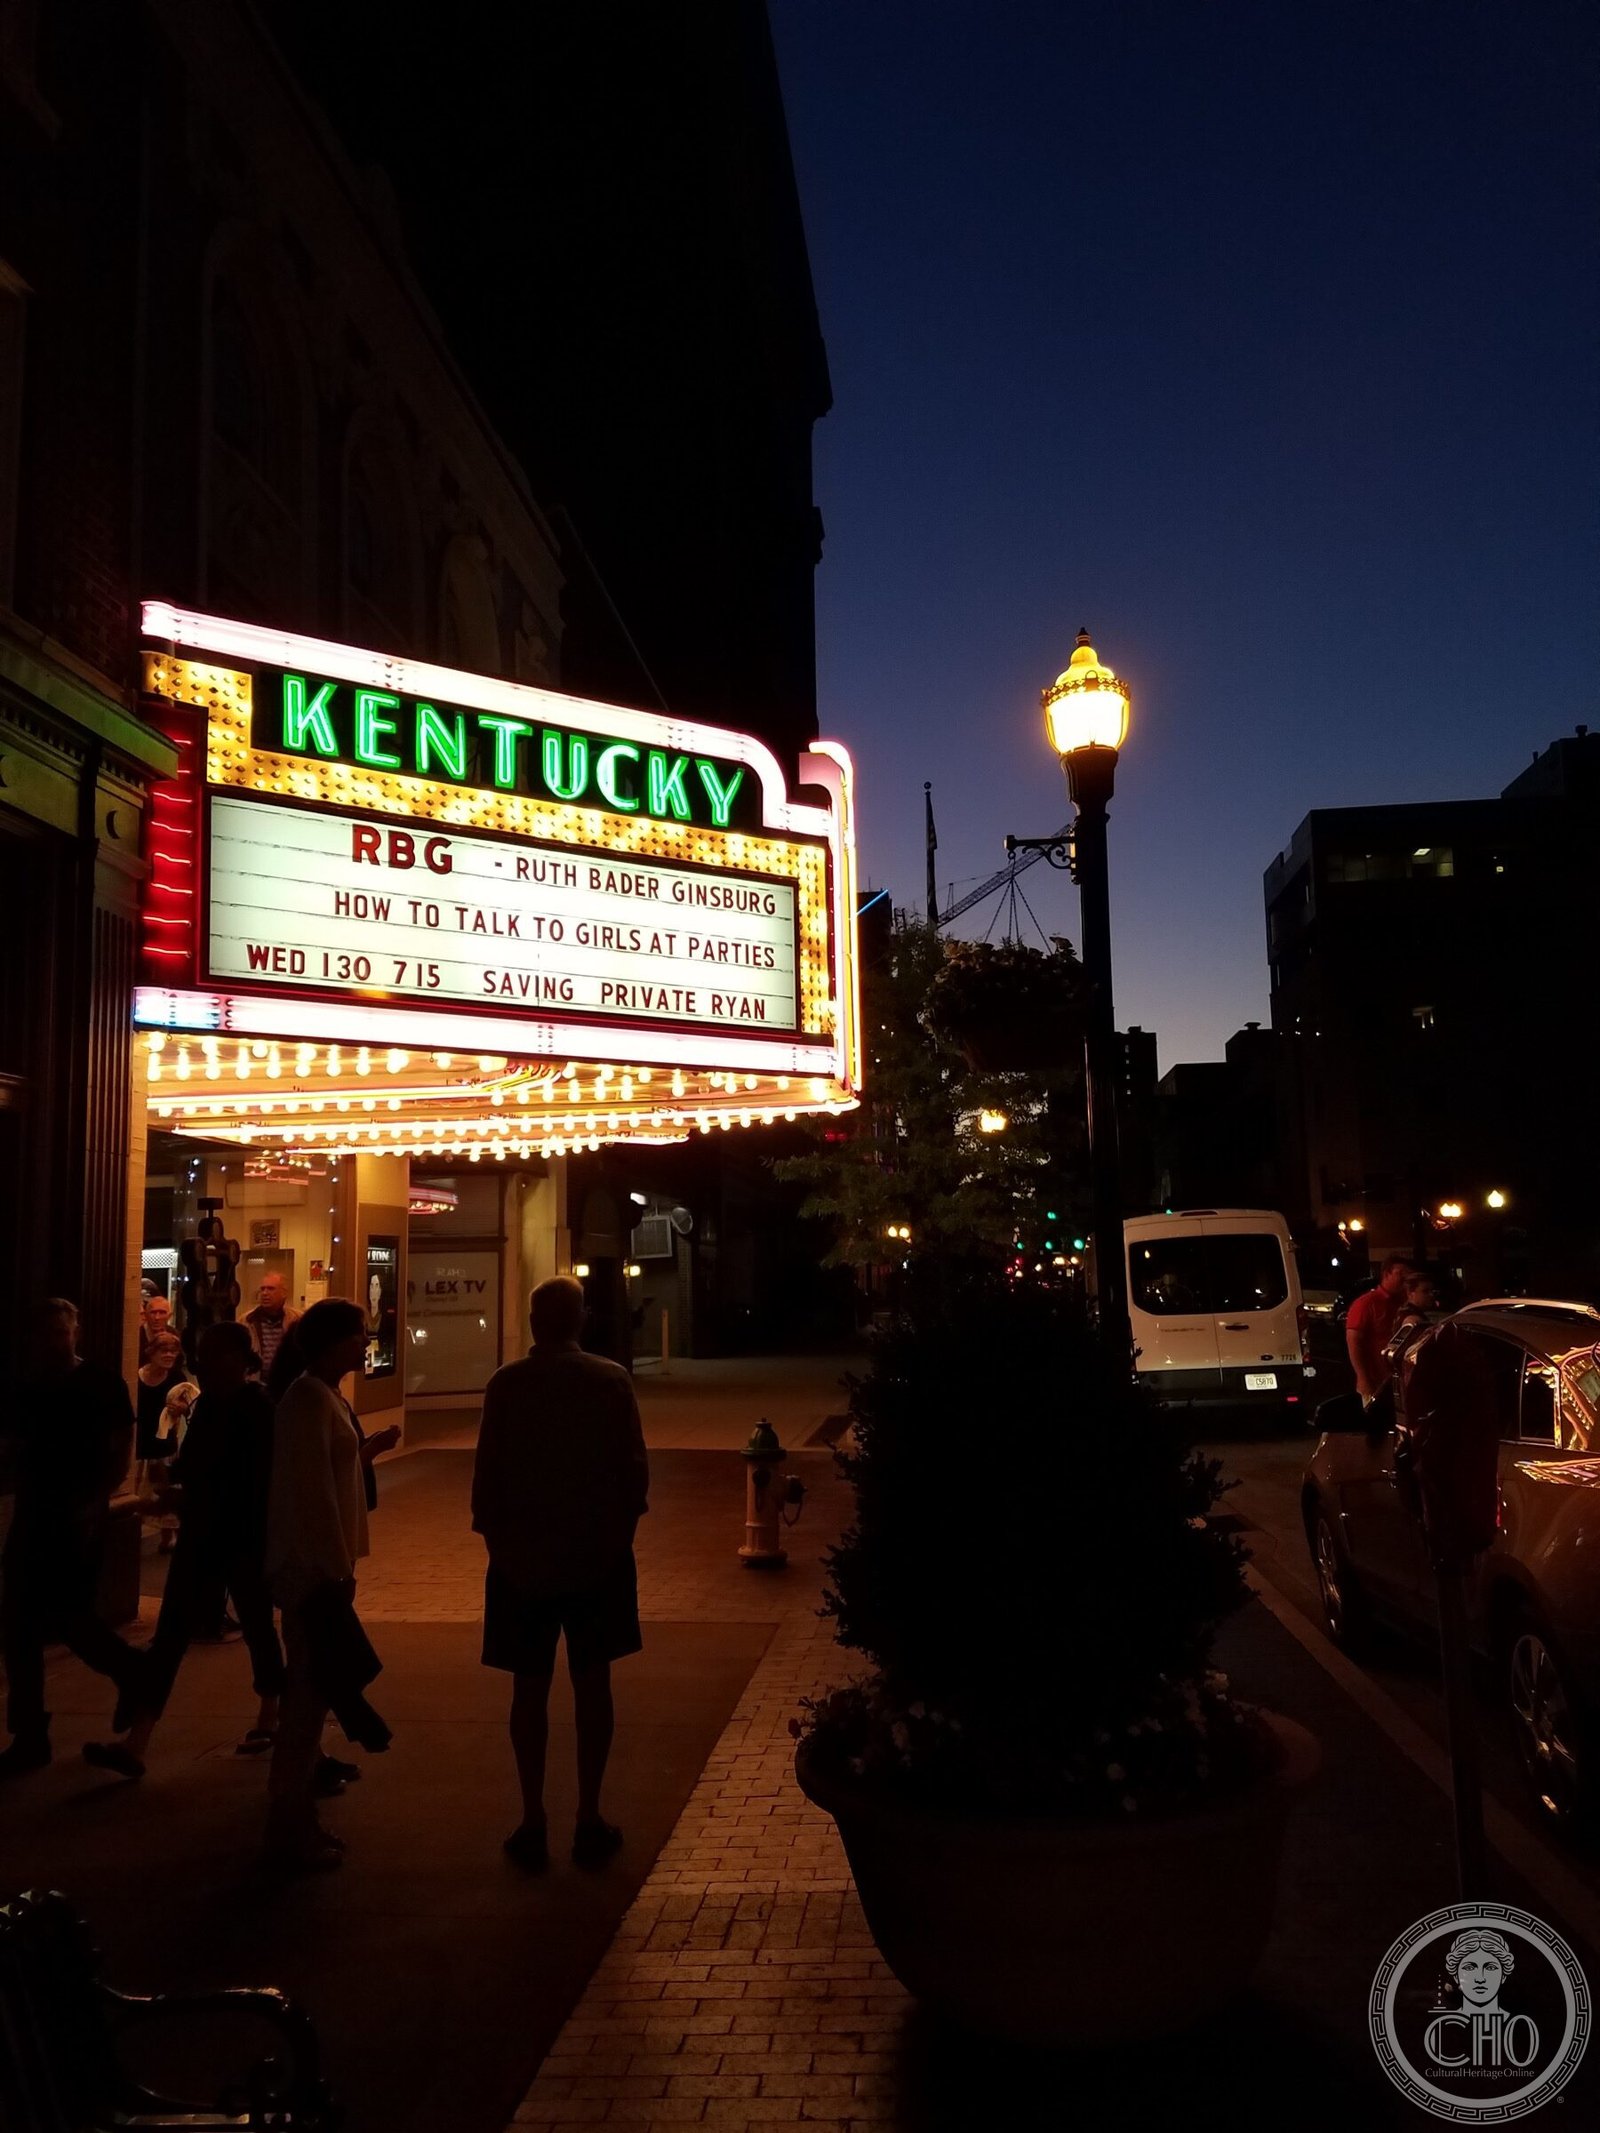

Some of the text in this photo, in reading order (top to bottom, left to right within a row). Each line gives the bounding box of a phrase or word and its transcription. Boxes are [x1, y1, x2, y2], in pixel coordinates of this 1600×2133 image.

[282, 673, 745, 828] KENTUCKY
[352, 823, 453, 875] RBG
[516, 857, 577, 887] RUTH
[589, 868, 659, 898] BADER
[672, 880, 776, 915] GINSBURG
[334, 890, 775, 968] HOW TO TALK TO GIRLS AT PARTIES
[246, 944, 766, 1020] WED 130 715 SAVING PRIVATE RYAN
[425, 1280, 487, 1295] LEX TV
